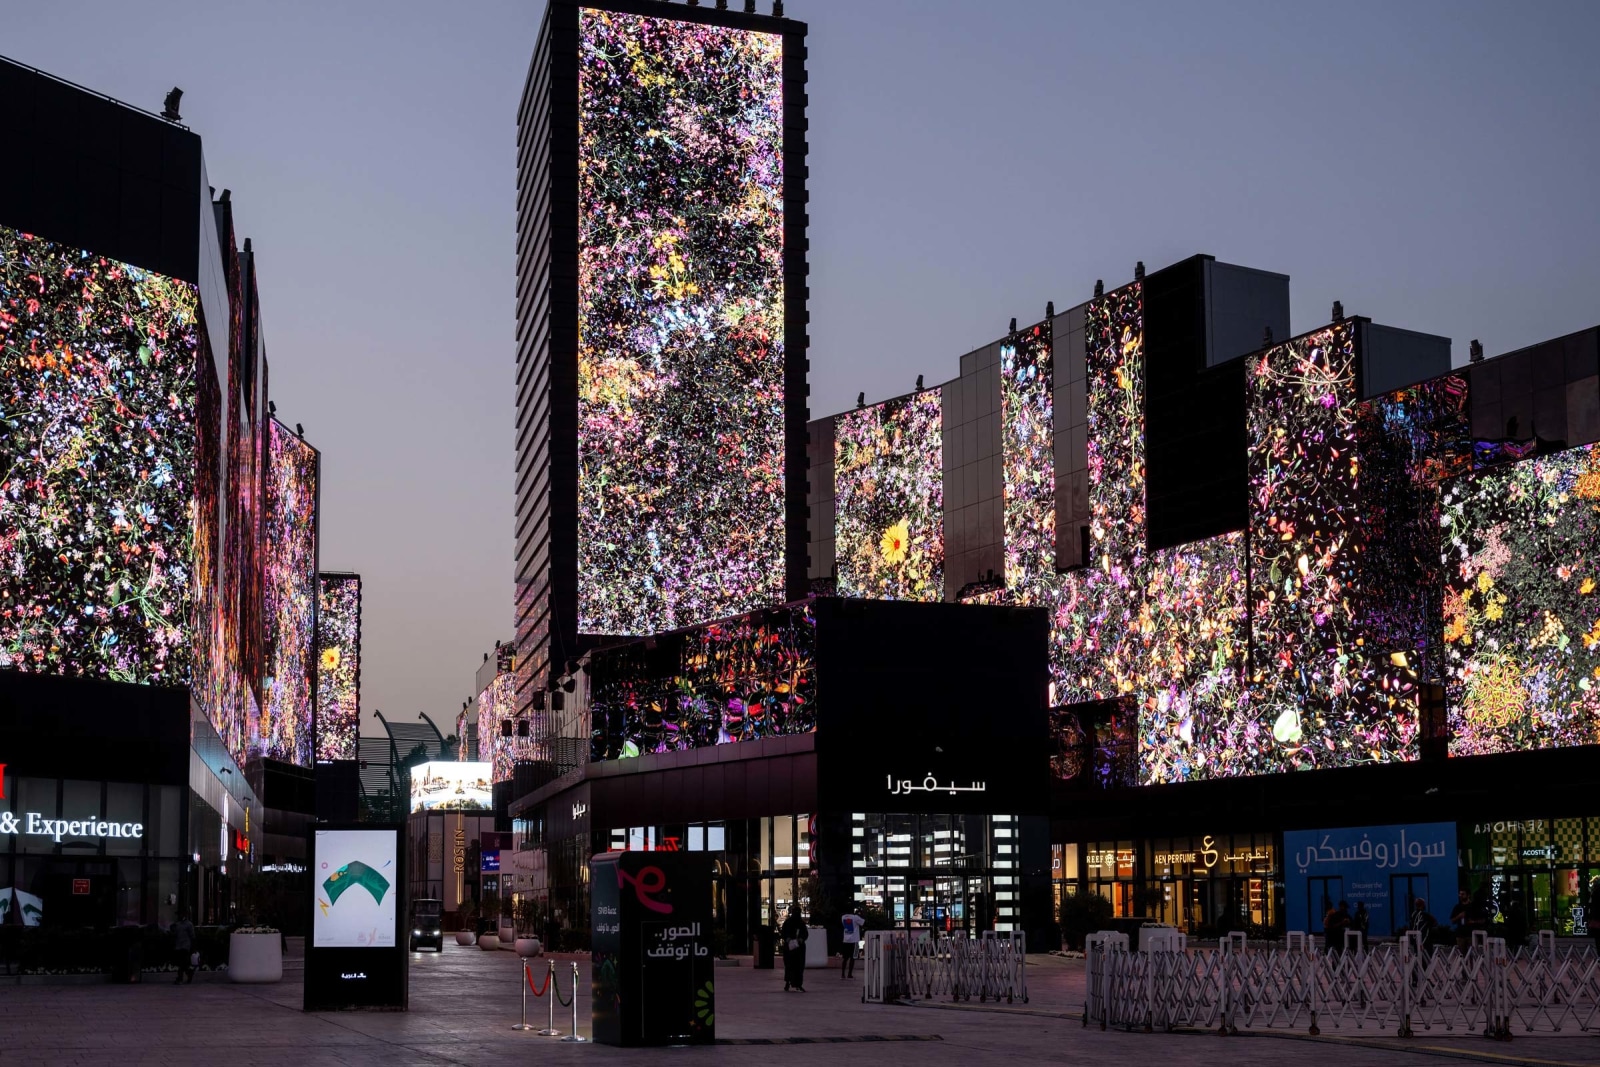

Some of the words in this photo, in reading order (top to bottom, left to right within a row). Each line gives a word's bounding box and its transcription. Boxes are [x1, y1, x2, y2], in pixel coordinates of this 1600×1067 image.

[887, 772, 986, 795] سيفورا
[0, 812, 21, 835] &
[25, 812, 144, 843] Experience
[453, 829, 466, 873] ROSHN
[1167, 853, 1196, 864] PERFUME
[1296, 829, 1447, 874] سواروفسكي
[1520, 849, 1546, 857] ACOSTE
[1086, 855, 1104, 864] REEF
[1372, 890, 1389, 899] crystal
[647, 943, 690, 961] توقف
[694, 941, 709, 956] ما
